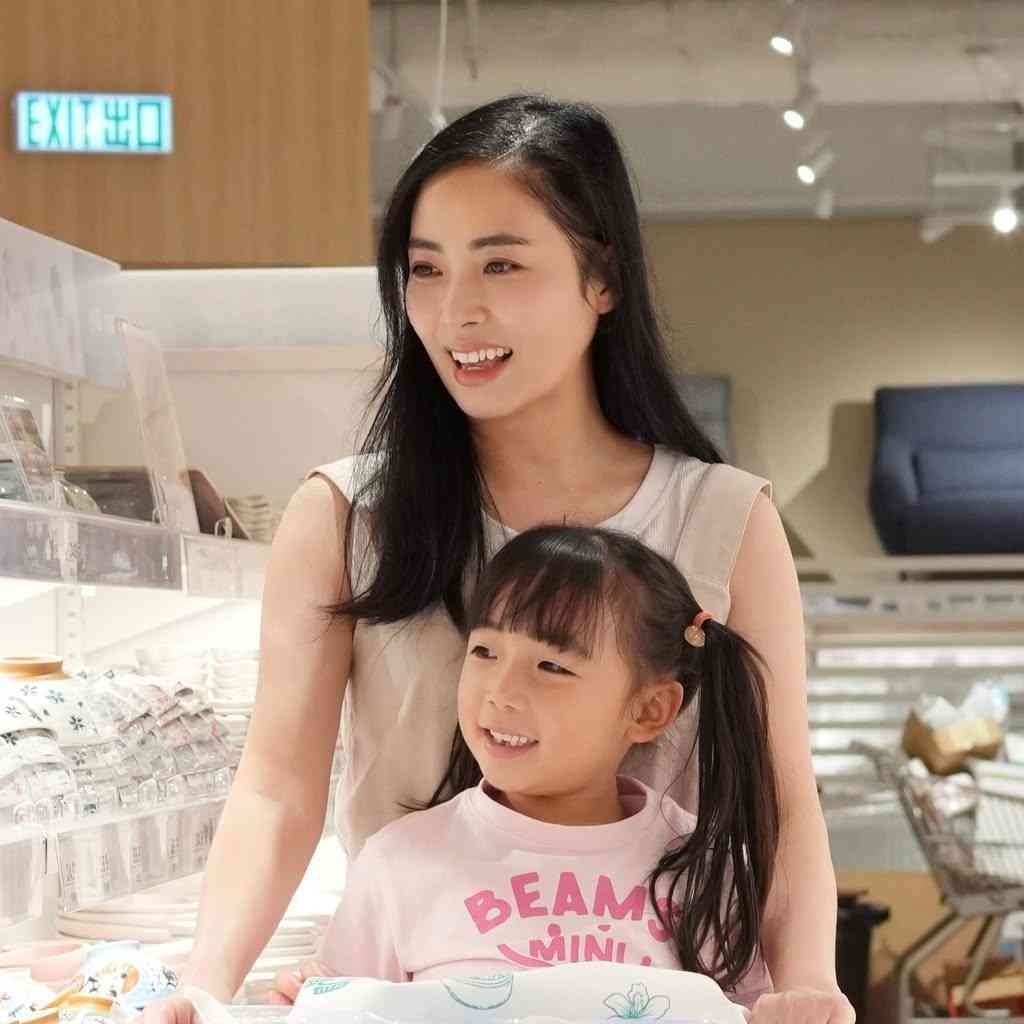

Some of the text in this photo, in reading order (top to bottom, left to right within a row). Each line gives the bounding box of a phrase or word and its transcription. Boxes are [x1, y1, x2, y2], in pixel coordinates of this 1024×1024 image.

[27, 97, 163, 147] EXIT 出口
[529, 934, 626, 963] MINI
